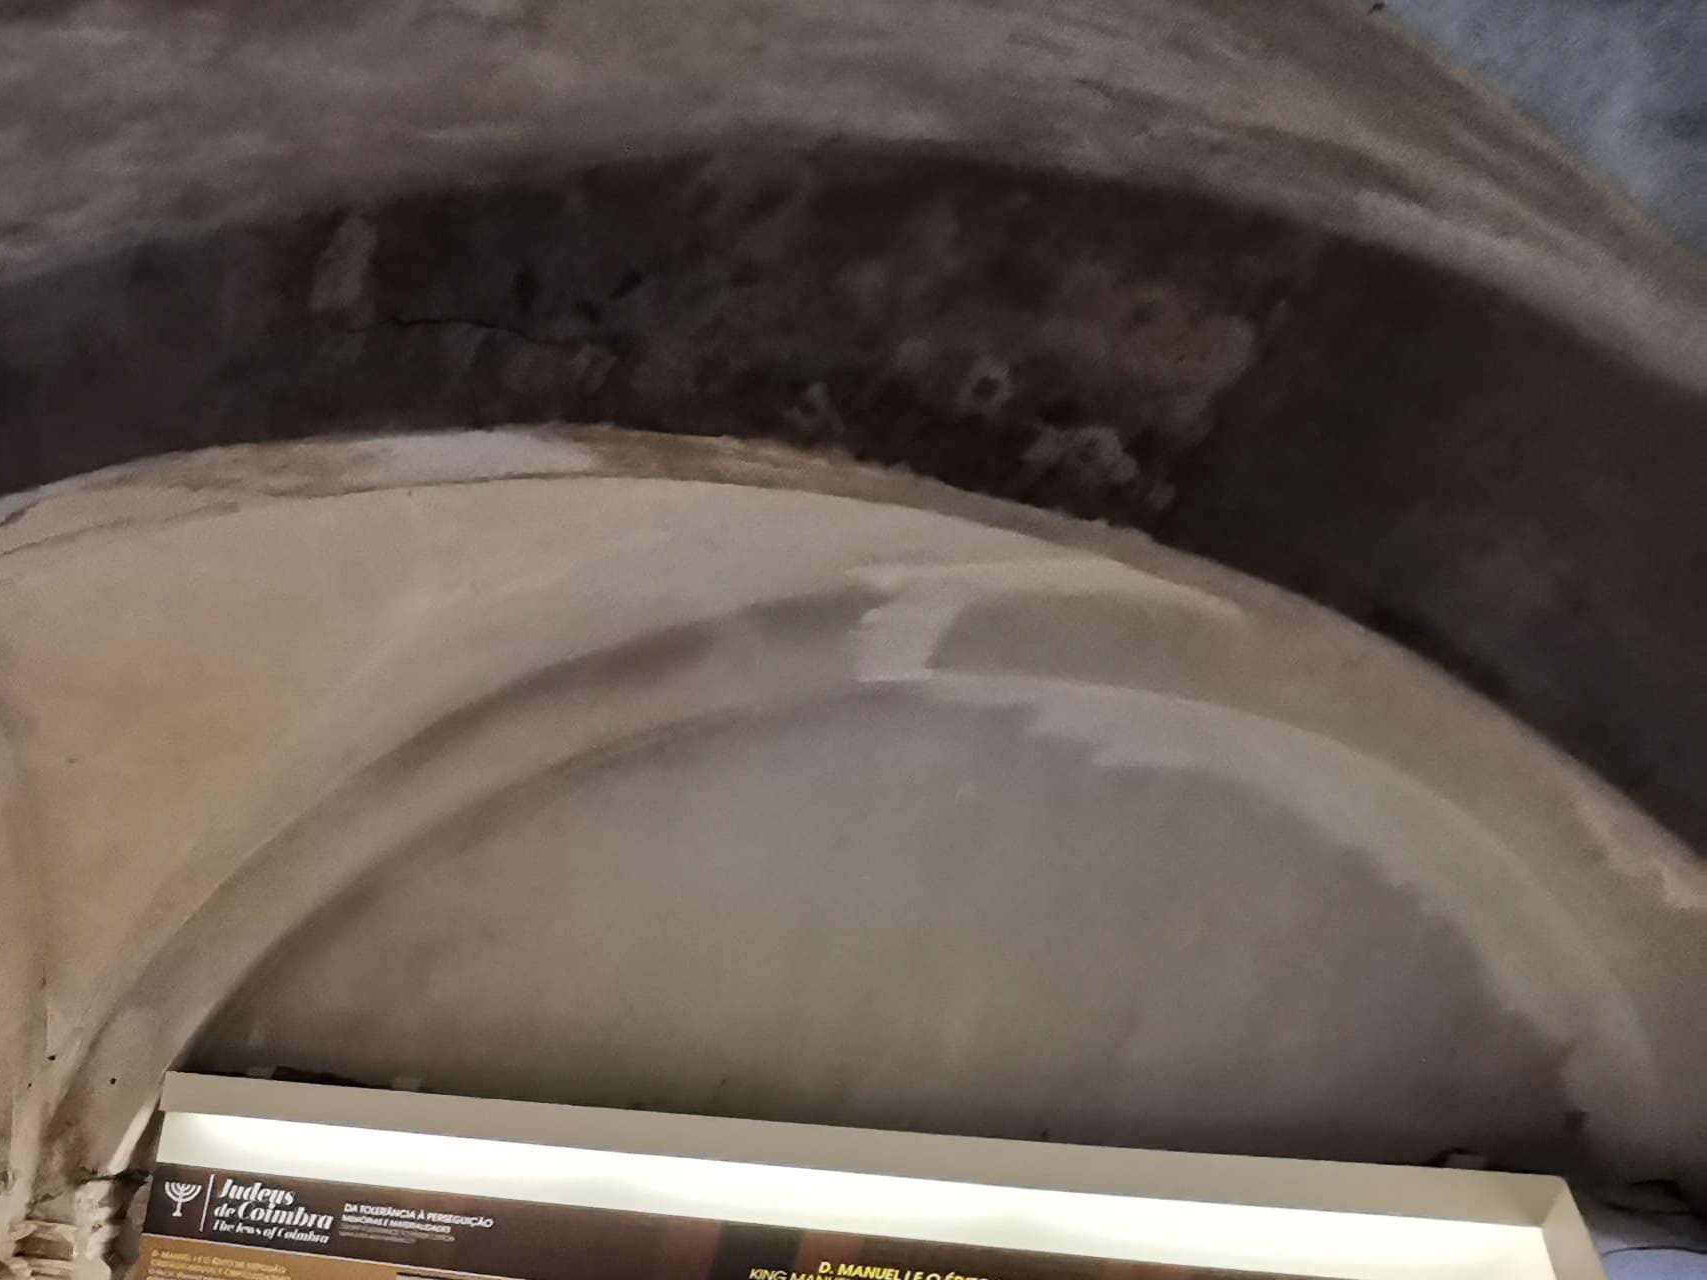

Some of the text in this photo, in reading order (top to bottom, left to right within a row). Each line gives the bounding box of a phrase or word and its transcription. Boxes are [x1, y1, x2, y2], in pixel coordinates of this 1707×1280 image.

[219, 1178, 295, 1205] Judeus
[213, 1200, 334, 1229] de Coimbra
[344, 1203, 357, 1213] DA
[359, 1204, 416, 1220] TOLERÂNCIA
[426, 1212, 494, 1228] PERSEGUIÇÃO
[213, 1219, 235, 1231] The
[236, 1222, 261, 1235] Jews
[263, 1226, 278, 1240] of
[277, 1228, 330, 1244] Coimbra
[818, 1261, 834, 1275] D.
